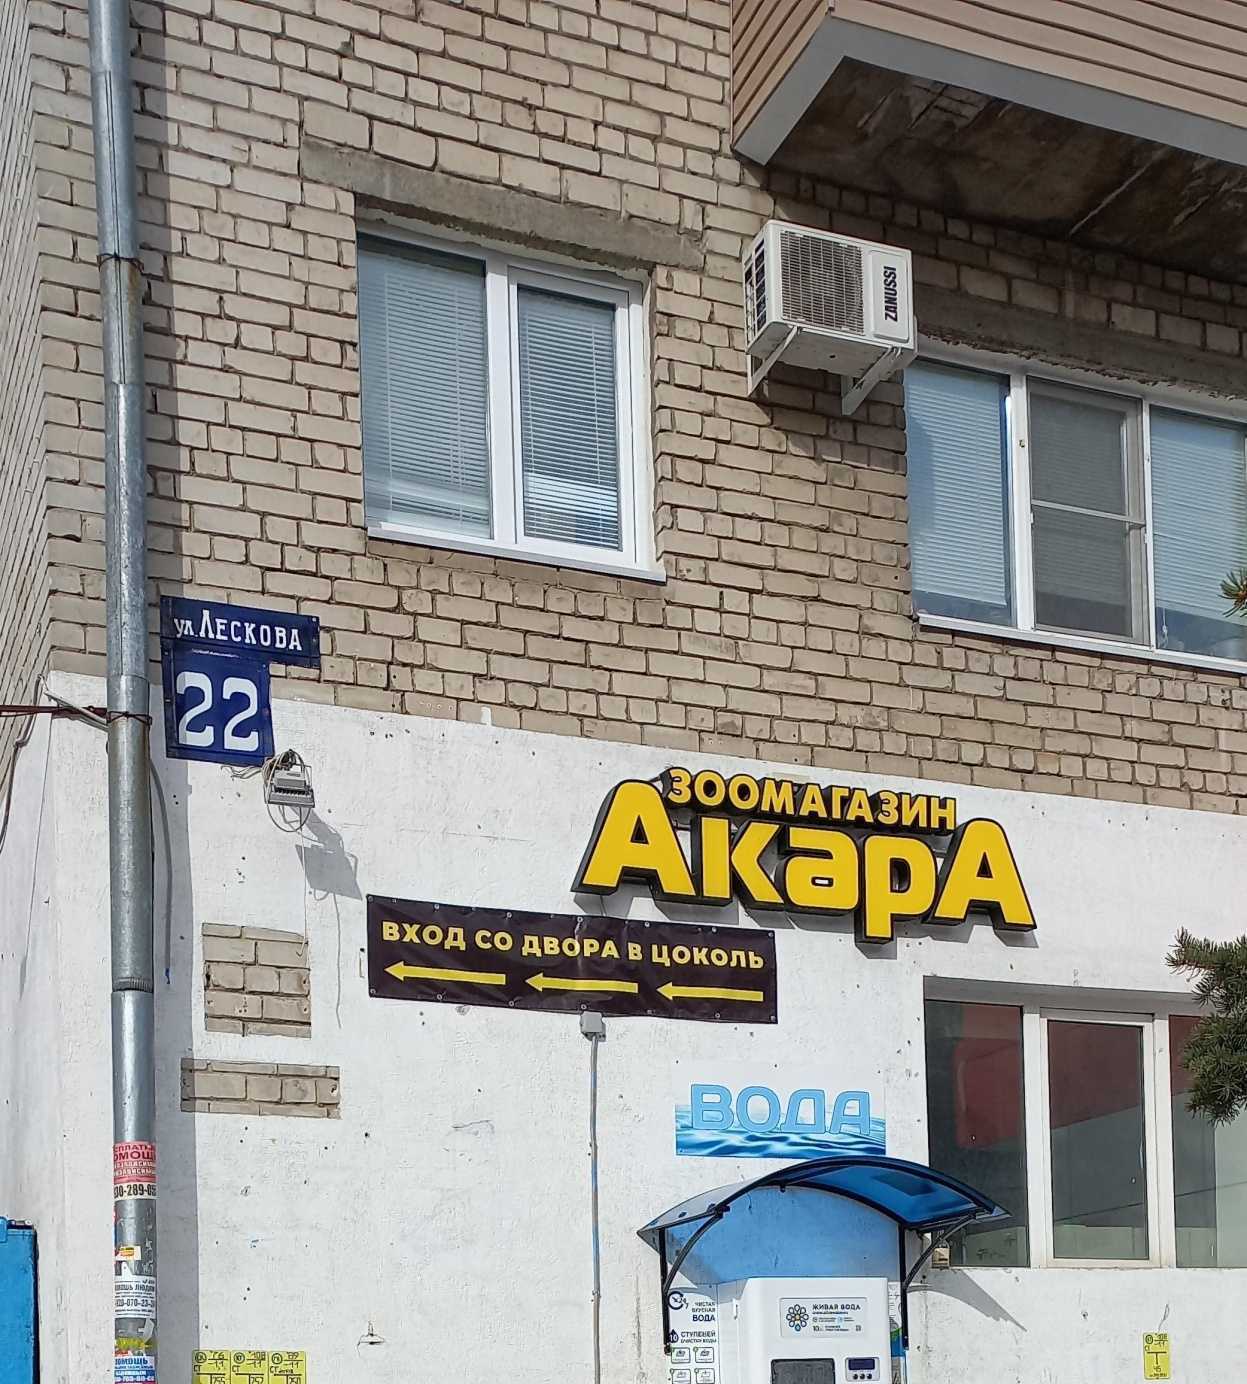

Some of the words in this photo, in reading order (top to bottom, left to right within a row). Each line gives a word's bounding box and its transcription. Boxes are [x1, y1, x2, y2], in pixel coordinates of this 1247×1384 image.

[883, 265, 898, 322] ZANUSSI
[176, 671, 259, 751] 22
[666, 767, 957, 831] ЗООМАГАЗИН
[382, 920, 466, 951] ВХОД
[475, 929, 513, 951] СО
[521, 934, 620, 961] ДВОРА
[628, 943, 642, 961] В
[651, 945, 764, 969] ЦОКОЛЬ
[691, 1083, 871, 1136] ВОДА
[692, 1314, 716, 1322] ВОДА
[812, 1303, 839, 1311] ЖИВАЯ
[840, 1303, 861, 1311] ВОДА
